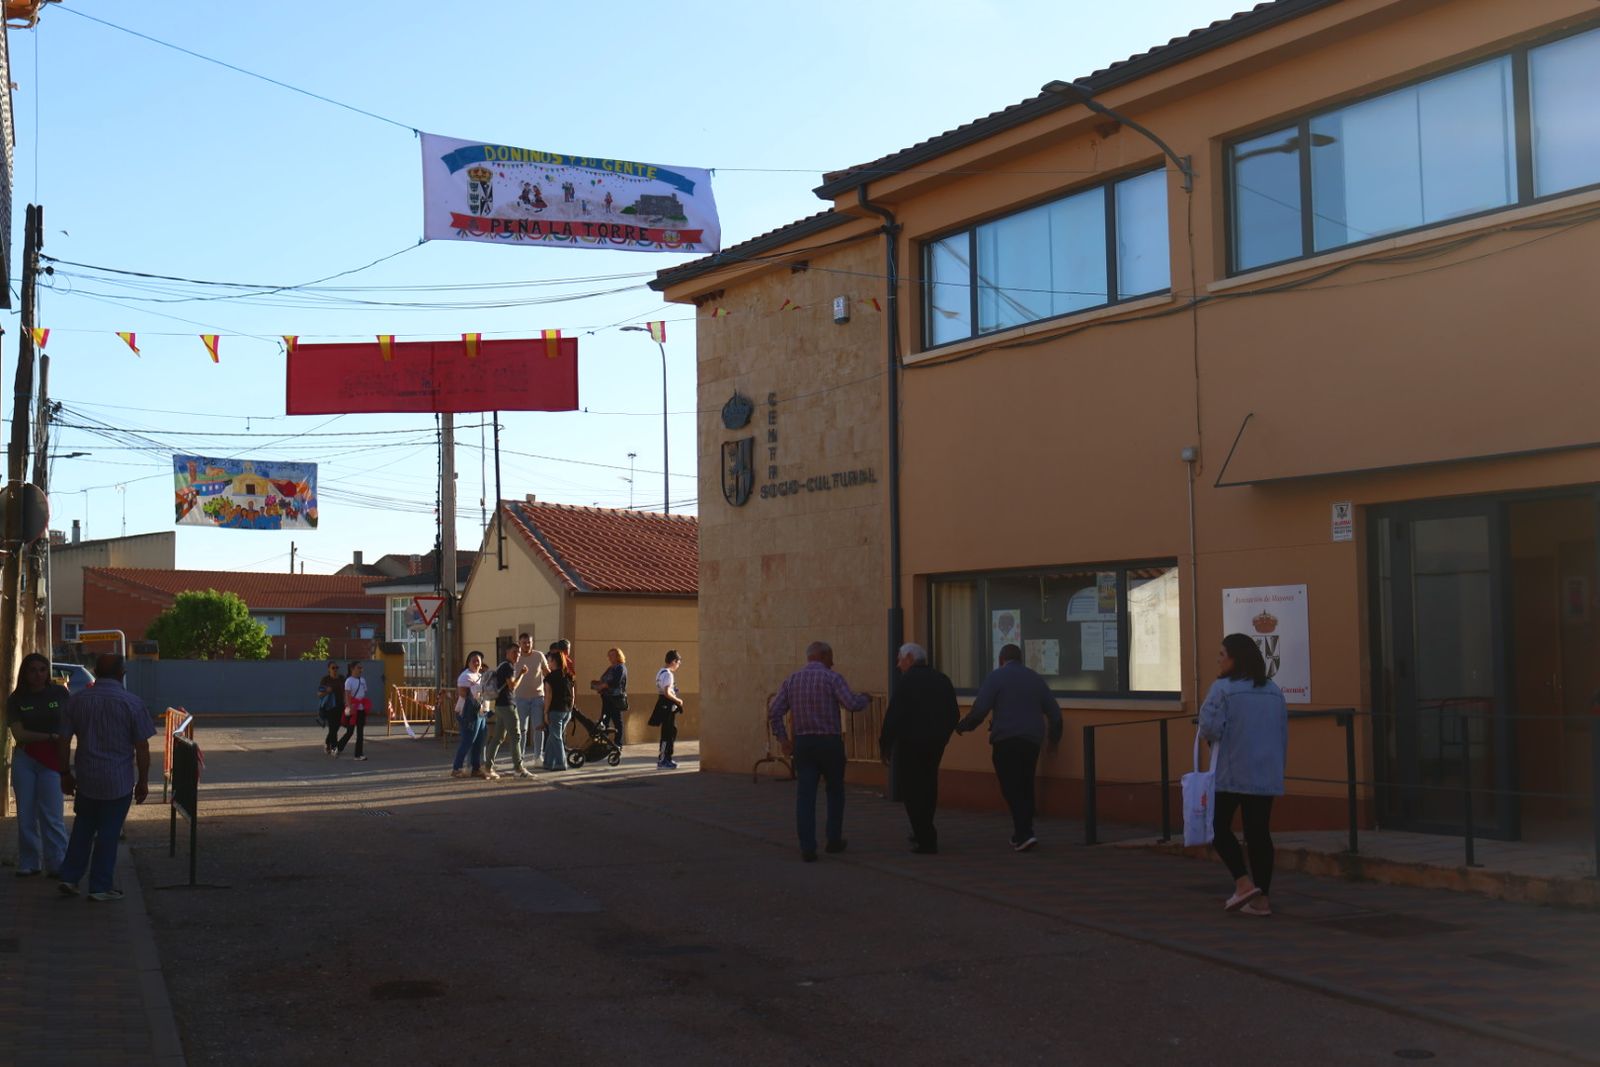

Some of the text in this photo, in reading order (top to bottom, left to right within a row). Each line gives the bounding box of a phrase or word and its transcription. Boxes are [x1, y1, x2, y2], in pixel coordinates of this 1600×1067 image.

[601, 159, 658, 179] GENTE
[490, 217, 649, 241] PEÑA LA TORRE
